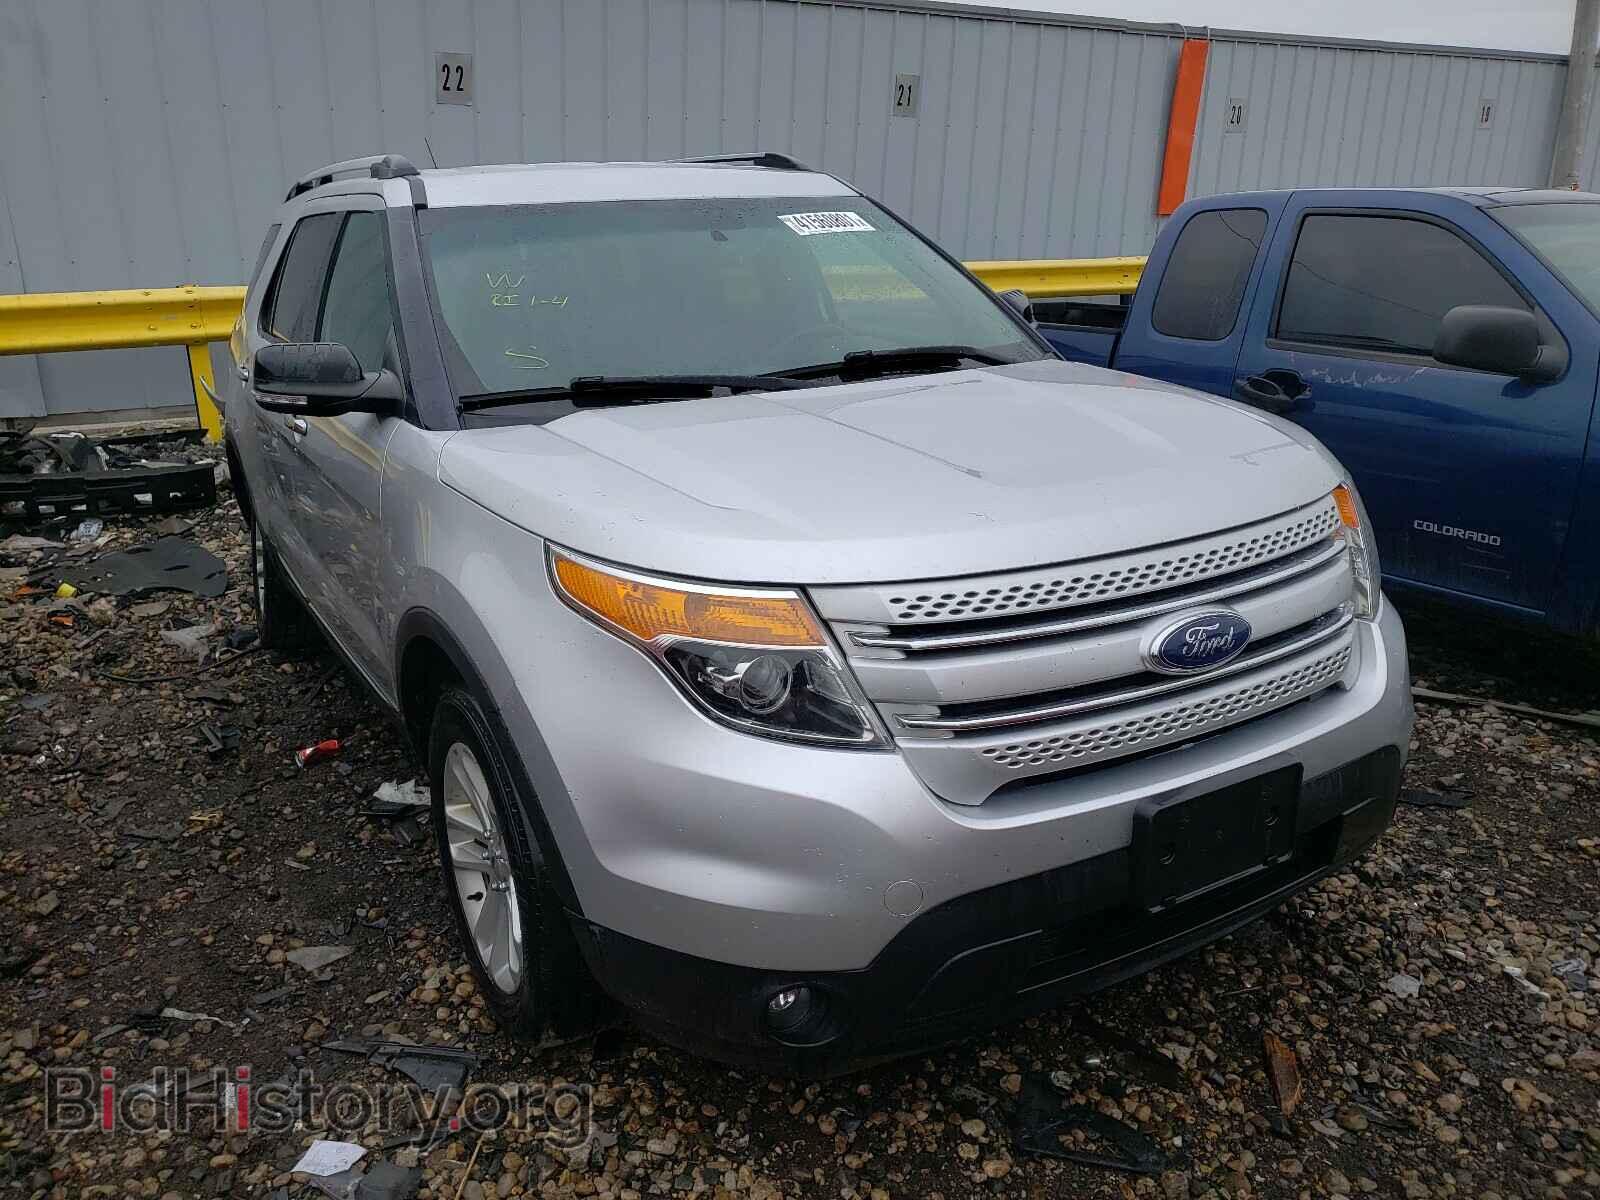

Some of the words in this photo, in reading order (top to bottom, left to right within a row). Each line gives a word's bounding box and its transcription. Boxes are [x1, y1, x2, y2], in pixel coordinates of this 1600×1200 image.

[442, 63, 465, 92] 22
[896, 84, 912, 107] 21
[1230, 104, 1242, 125] 20
[1413, 519, 1501, 546] COLORADO
[1182, 623, 1236, 657] Ford
